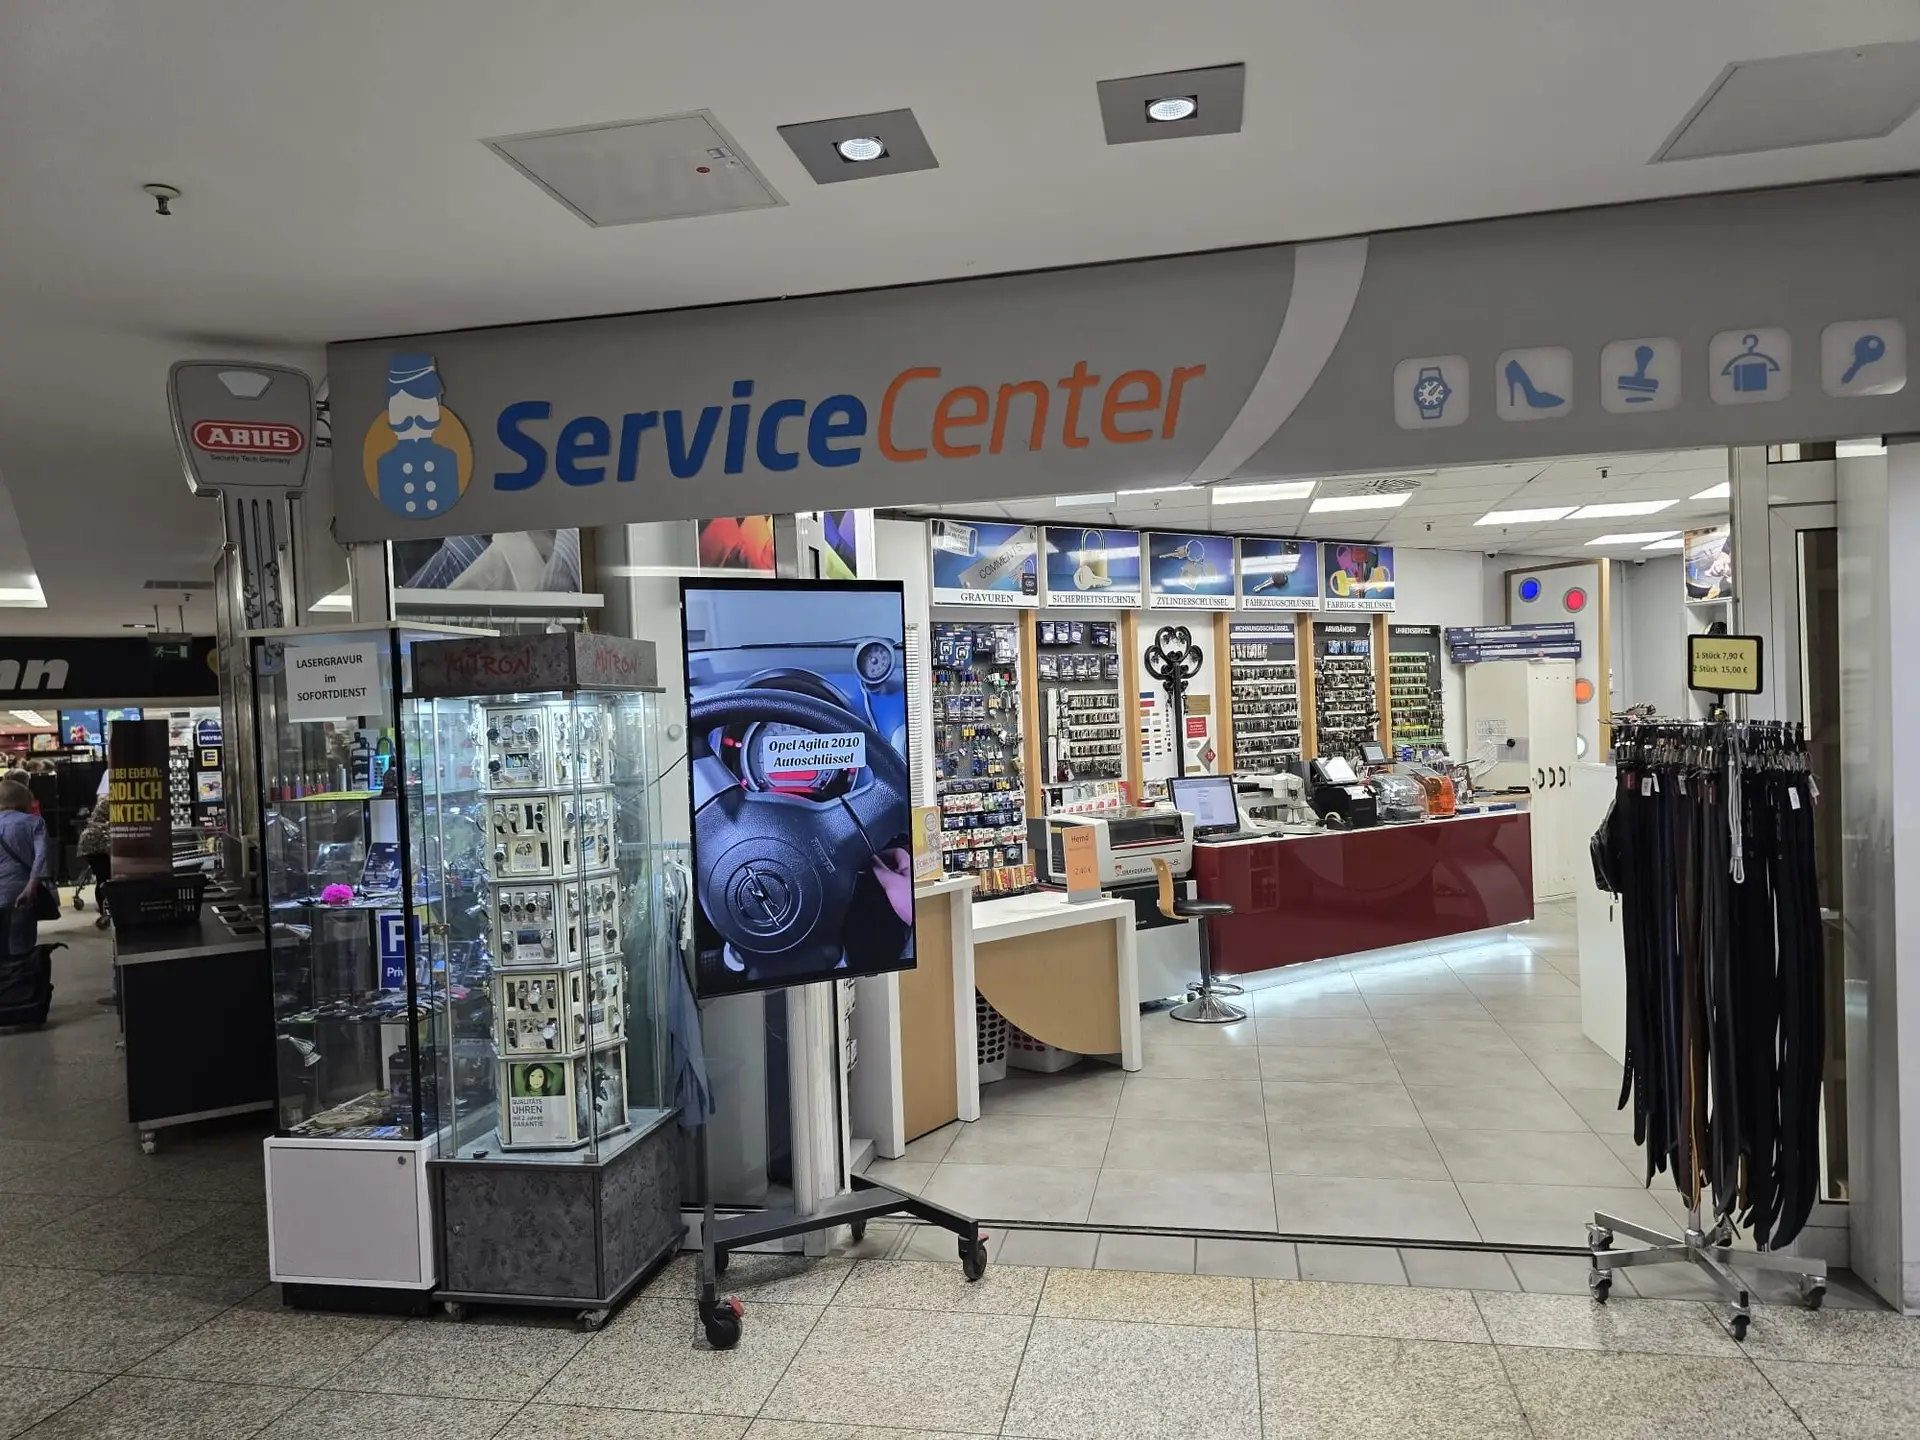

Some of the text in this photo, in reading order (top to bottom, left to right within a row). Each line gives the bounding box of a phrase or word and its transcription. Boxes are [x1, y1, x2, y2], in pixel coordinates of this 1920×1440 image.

[206, 427, 290, 448] ABUS
[960, 592, 1014, 603] GRAVUREN
[1052, 594, 1137, 605] SICHERHEITSTECHNIK
[1156, 596, 1230, 607] ZYLINDERSCHLÜSSEL
[1245, 598, 1317, 608] FAHRZEUGSCHLÜSSEL
[1326, 600, 1394, 610] FARBIGE SCHLÜSSEL
[1325, 625, 1357, 633] ARMBÄNDER
[296, 654, 363, 669] LASERGRAVUR
[1701, 651, 1721, 660] Stück
[1722, 652, 1738, 661] 7,90
[1739, 652, 1746, 660] €
[1699, 664, 1717, 673] Stück
[1722, 665, 1742, 674] 15,00
[1743, 666, 1749, 674] €
[324, 673, 336, 683] im
[297, 687, 367, 701] SOFORTDIENST
[769, 736, 860, 753] Opel Agila 2010
[773, 752, 854, 767] Autoschlüssel
[128, 767, 163, 778] EDEKA:
[512, 1105, 543, 1114] UHREN
